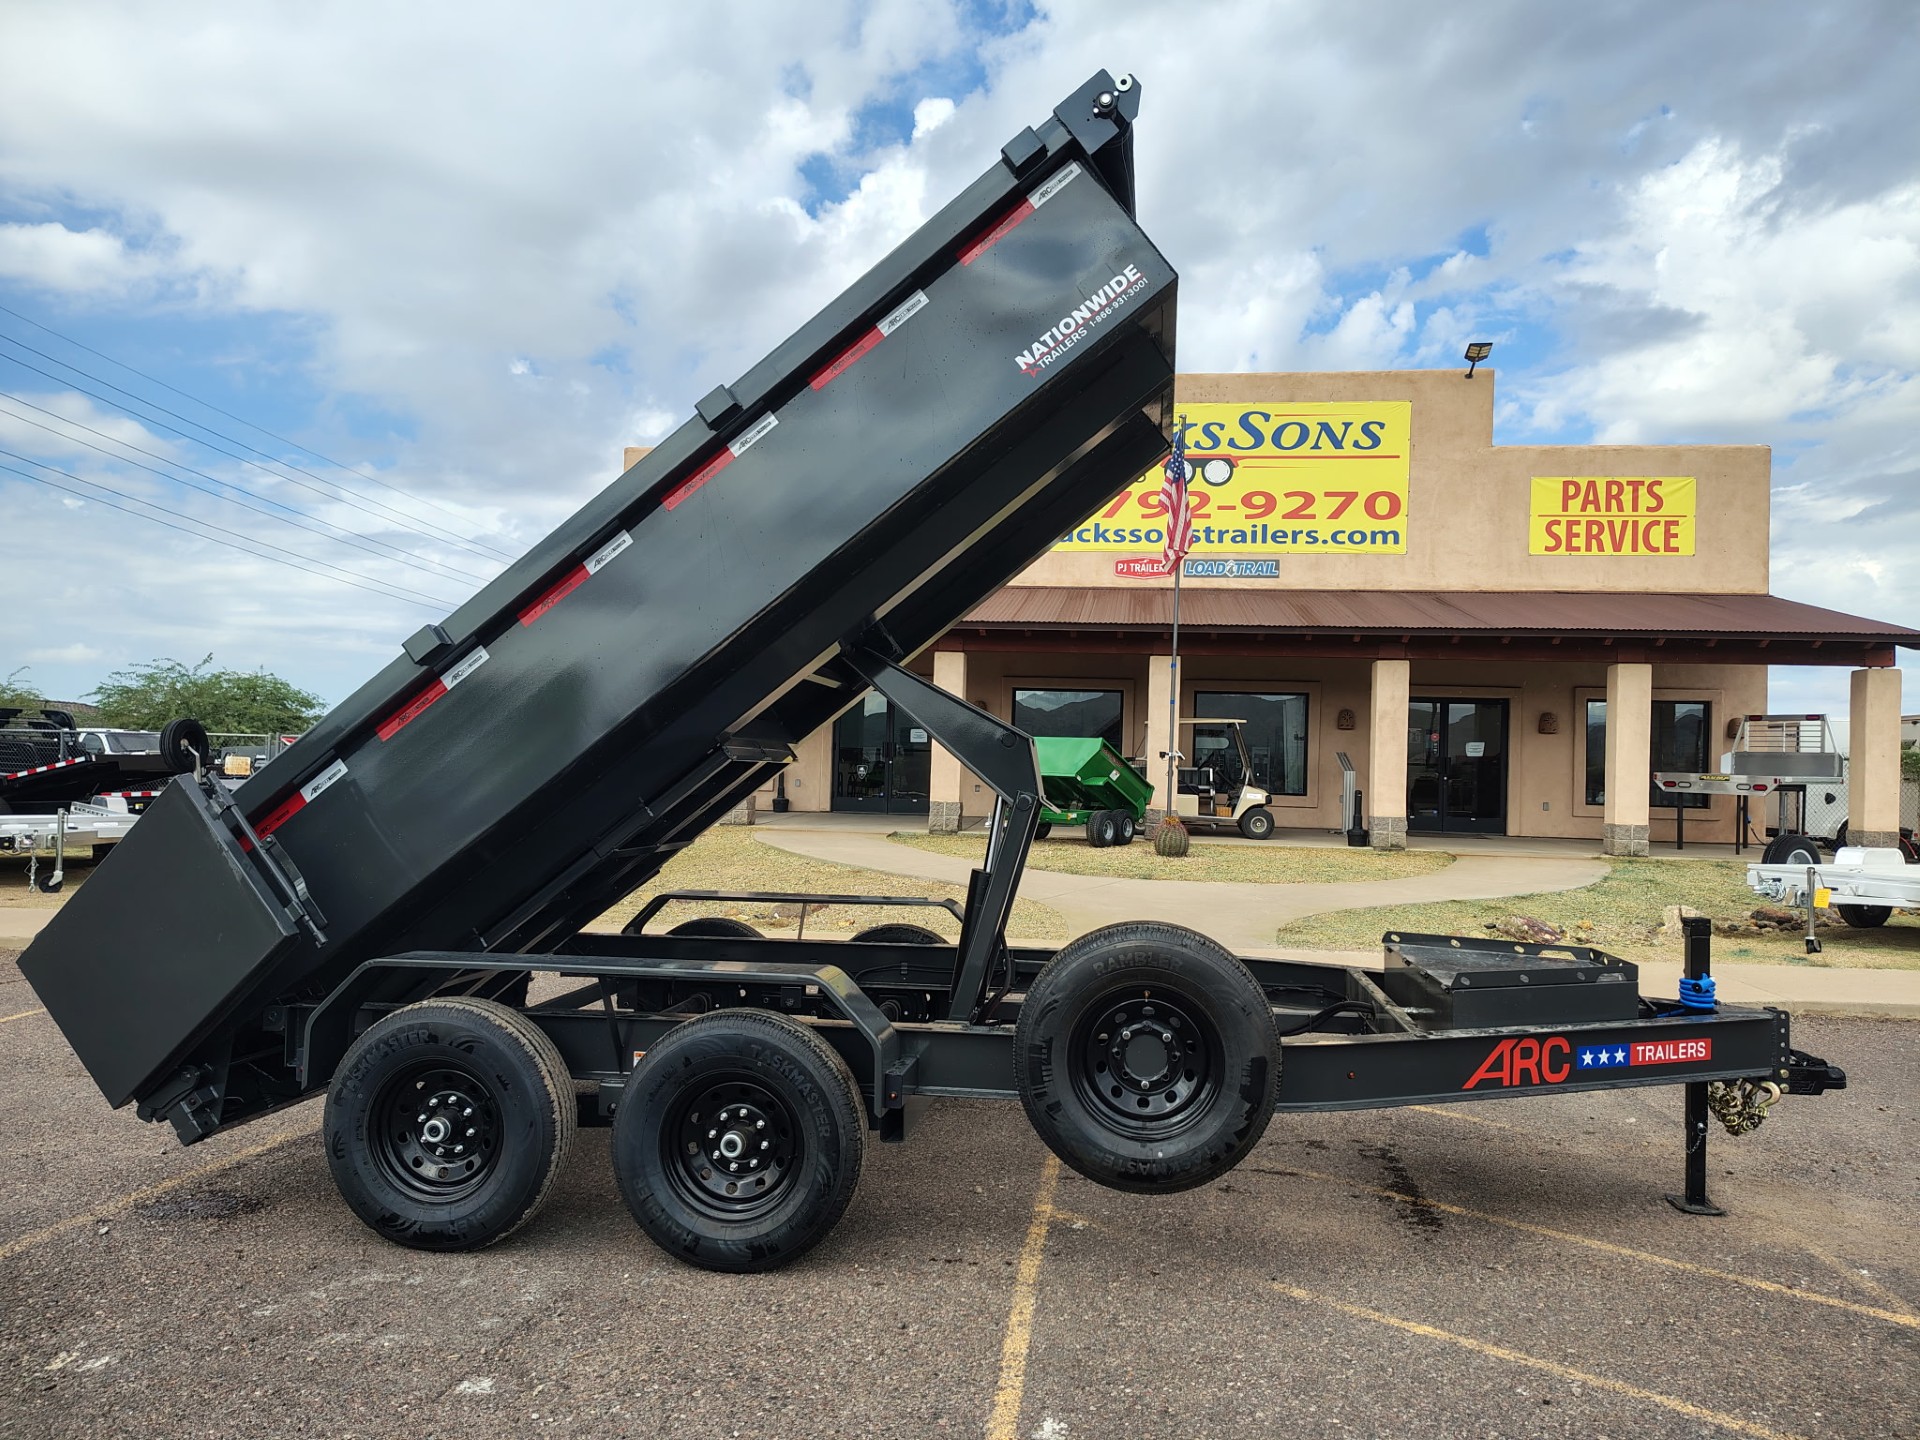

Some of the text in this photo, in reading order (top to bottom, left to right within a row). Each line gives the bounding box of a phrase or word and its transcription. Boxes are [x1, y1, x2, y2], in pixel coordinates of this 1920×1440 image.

[1015, 264, 1141, 370] NATIONWIDE
[1037, 277, 1148, 368] TRAILERS 1-866-931-3001
[1562, 480, 1664, 513] PARTS
[1060, 523, 1400, 546] ackssostrailers.com
[1544, 519, 1679, 553] SERVICE
[1117, 563, 1127, 572] PJ
[1185, 561, 1278, 575] LOAD TRAIL
[1093, 951, 1183, 976] RAMBLER
[1462, 1036, 1706, 1089] ARC TRAILERS
[751, 1043, 831, 1137] TASKMASTER
